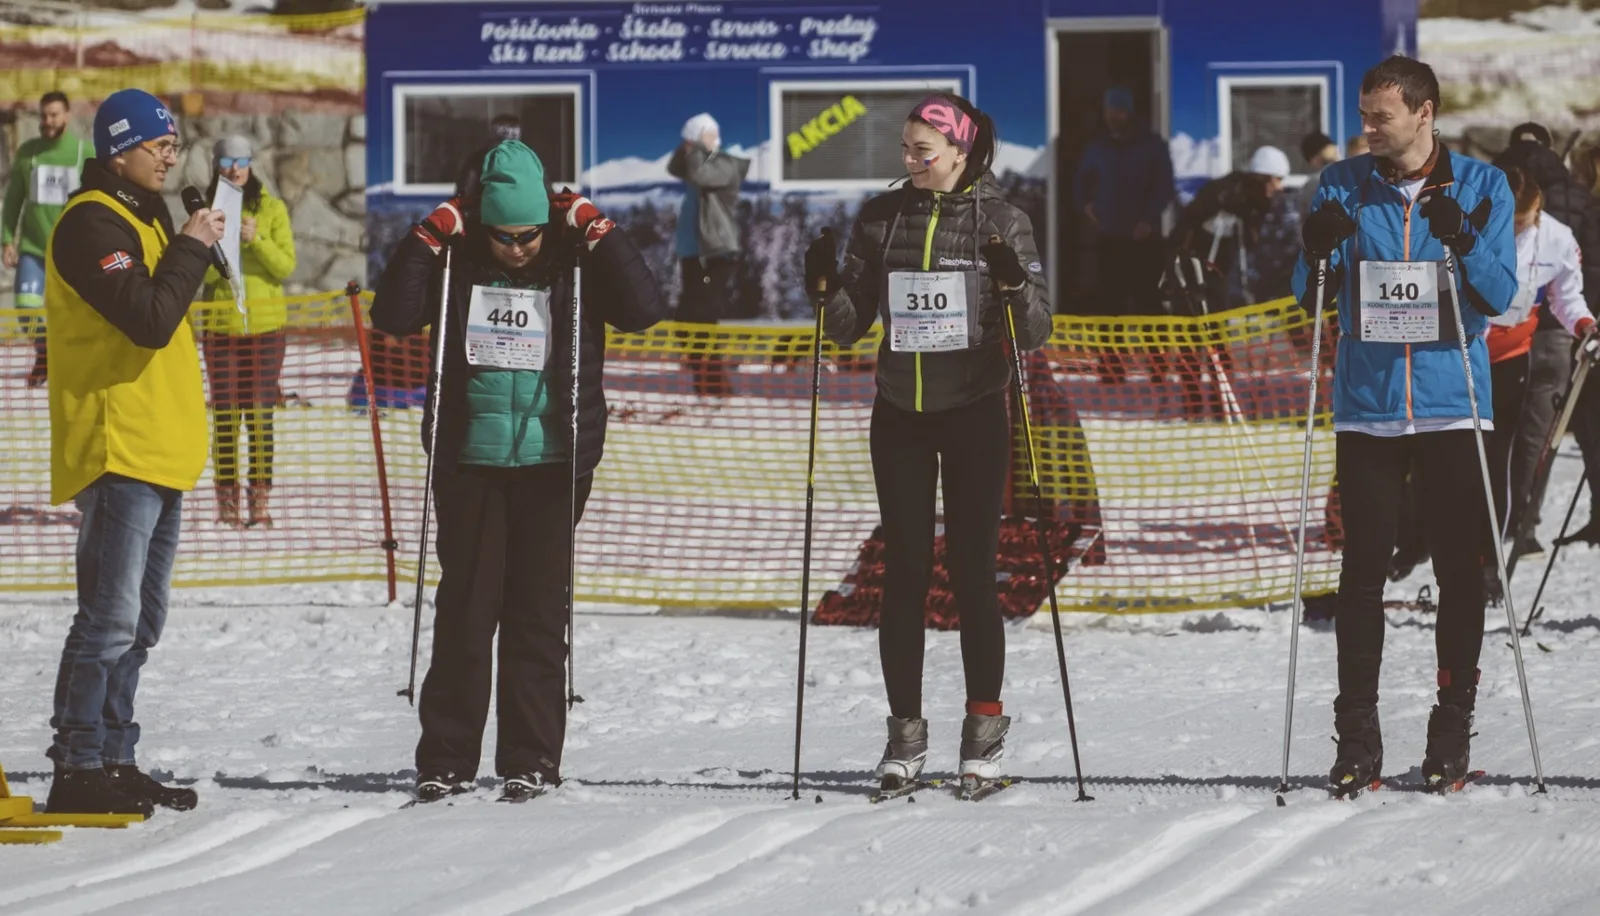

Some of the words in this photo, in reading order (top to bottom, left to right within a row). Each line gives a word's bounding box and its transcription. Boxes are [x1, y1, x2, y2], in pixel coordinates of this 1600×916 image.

[488, 41, 528, 64] Ski
[532, 40, 586, 63] Rent
[605, 40, 683, 62] School
[703, 41, 787, 60] Service
[787, 95, 867, 160] AKCIA
[1379, 283, 1419, 300] 140
[906, 293, 948, 311] 310
[487, 308, 528, 328] 440
